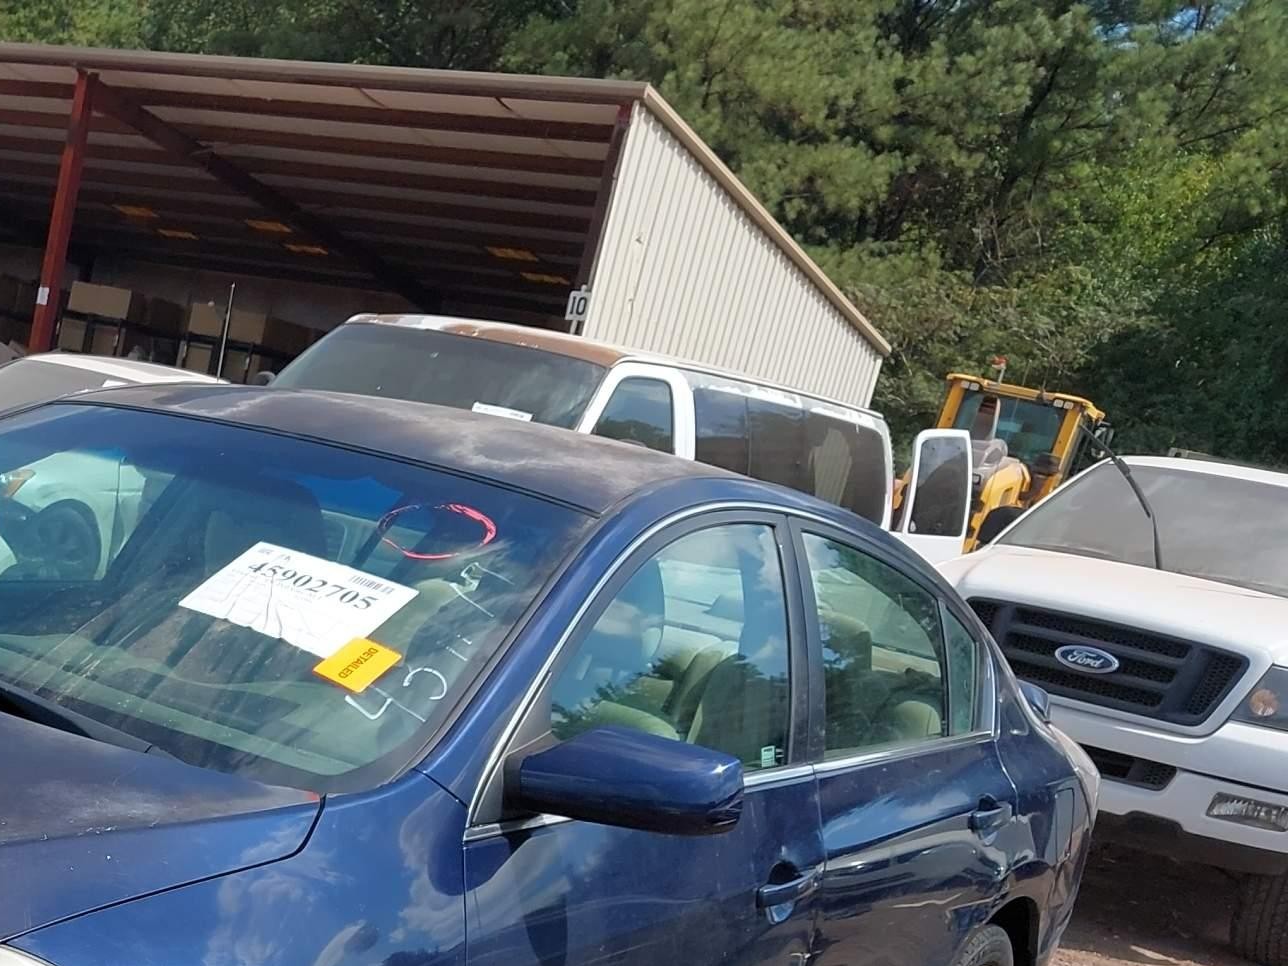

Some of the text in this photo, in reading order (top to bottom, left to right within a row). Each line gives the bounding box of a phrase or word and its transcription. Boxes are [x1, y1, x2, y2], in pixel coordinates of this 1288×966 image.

[569, 296, 587, 315] 10
[248, 562, 379, 611] 45902705
[338, 647, 379, 680] DETAILED
[1067, 649, 1105, 668] Ford
